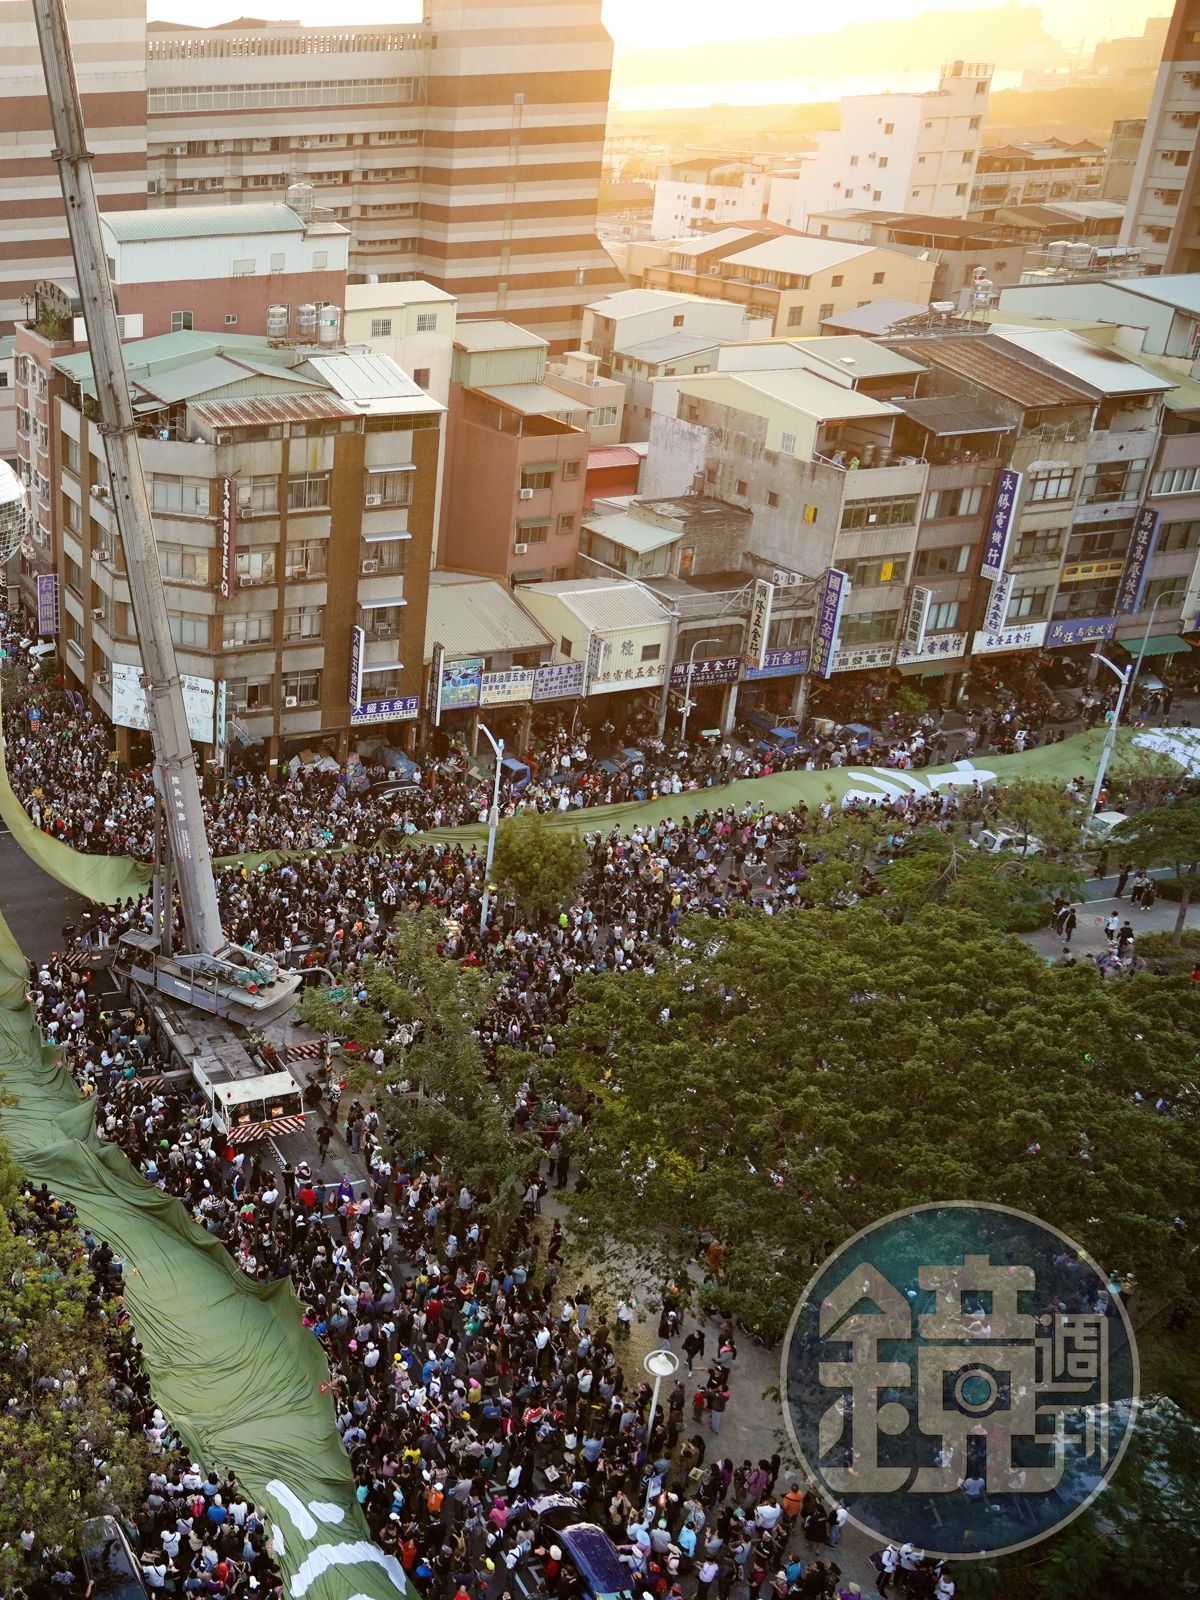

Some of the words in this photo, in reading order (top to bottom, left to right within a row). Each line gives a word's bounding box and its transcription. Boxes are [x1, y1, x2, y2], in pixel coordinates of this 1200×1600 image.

[987, 474, 1013, 566] 永勝電機行
[222, 519, 230, 580] HOTEL
[674, 657, 738, 675] 順隆五金行
[352, 698, 417, 716] 大盛五金行
[174, 980, 192, 991] DEMAG
